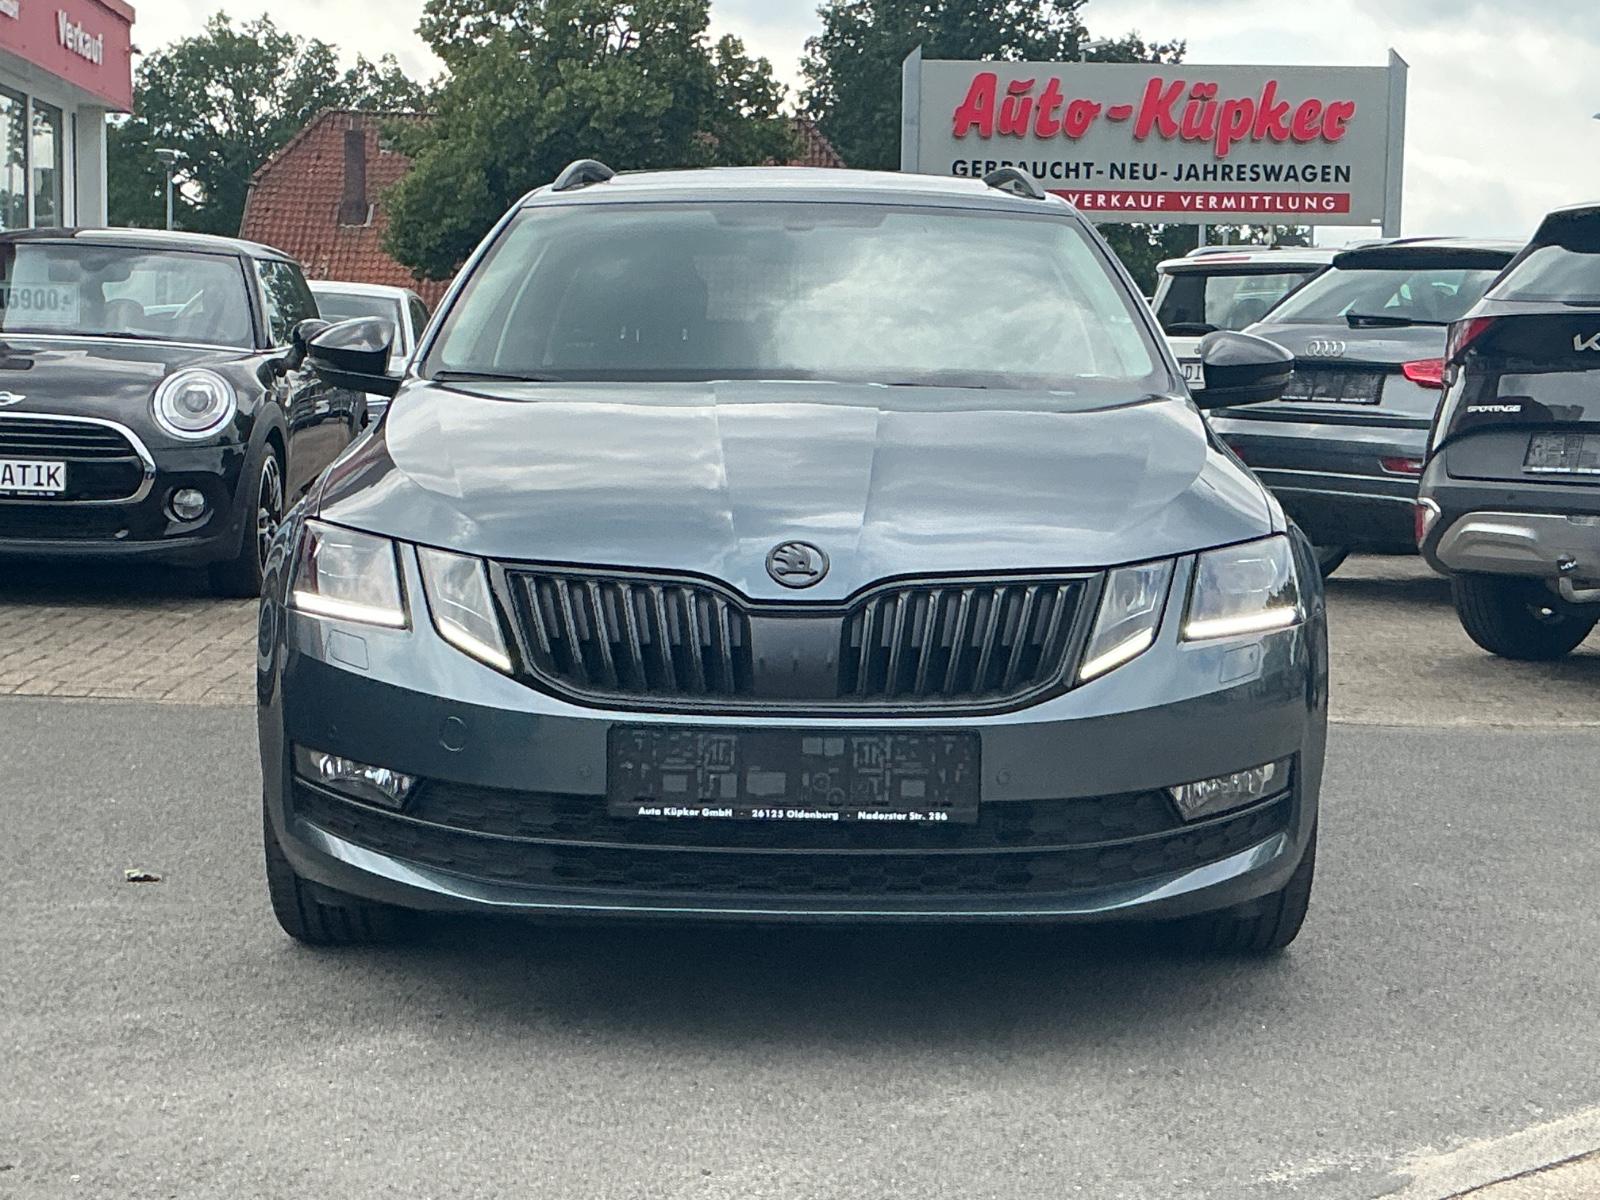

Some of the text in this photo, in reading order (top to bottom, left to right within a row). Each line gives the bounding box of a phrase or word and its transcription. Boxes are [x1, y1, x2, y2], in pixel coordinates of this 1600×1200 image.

[58, 9, 103, 65] Verkauf
[1068, 193, 1336, 210] VERKAUF VERMITTLUNG
[1467, 404, 1521, 413] SPORTAGE
[1, 463, 61, 487] ATIK
[701, 807, 733, 817] GmbH
[751, 808, 784, 819] 26125
[786, 809, 839, 821] Oldenburg
[909, 811, 926, 821] Str.
[928, 811, 948, 821] 286
